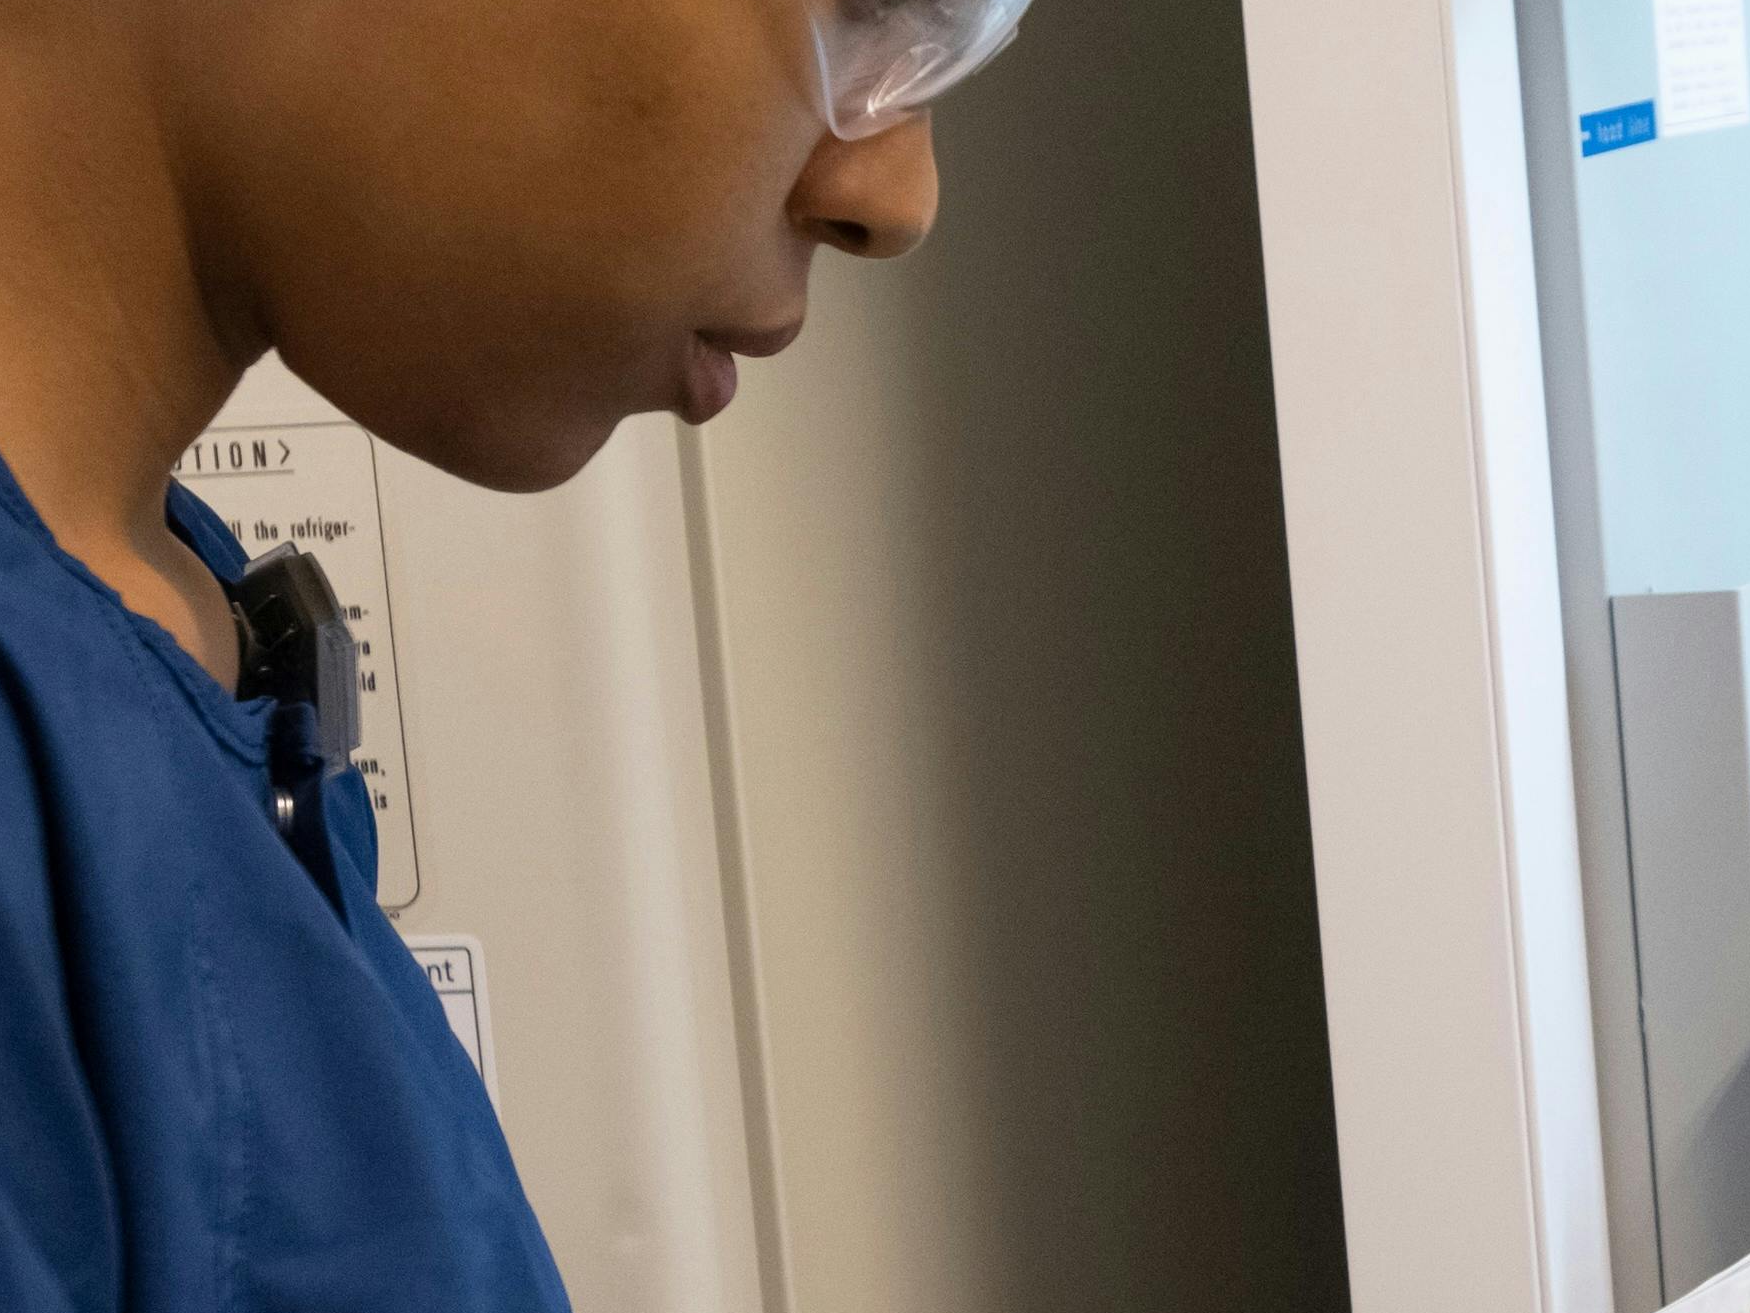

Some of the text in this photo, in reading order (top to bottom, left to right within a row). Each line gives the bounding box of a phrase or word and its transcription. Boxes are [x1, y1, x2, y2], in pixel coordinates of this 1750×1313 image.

[254, 520, 279, 541] the
[290, 516, 356, 543] refriger-
[373, 789, 389, 810] is
